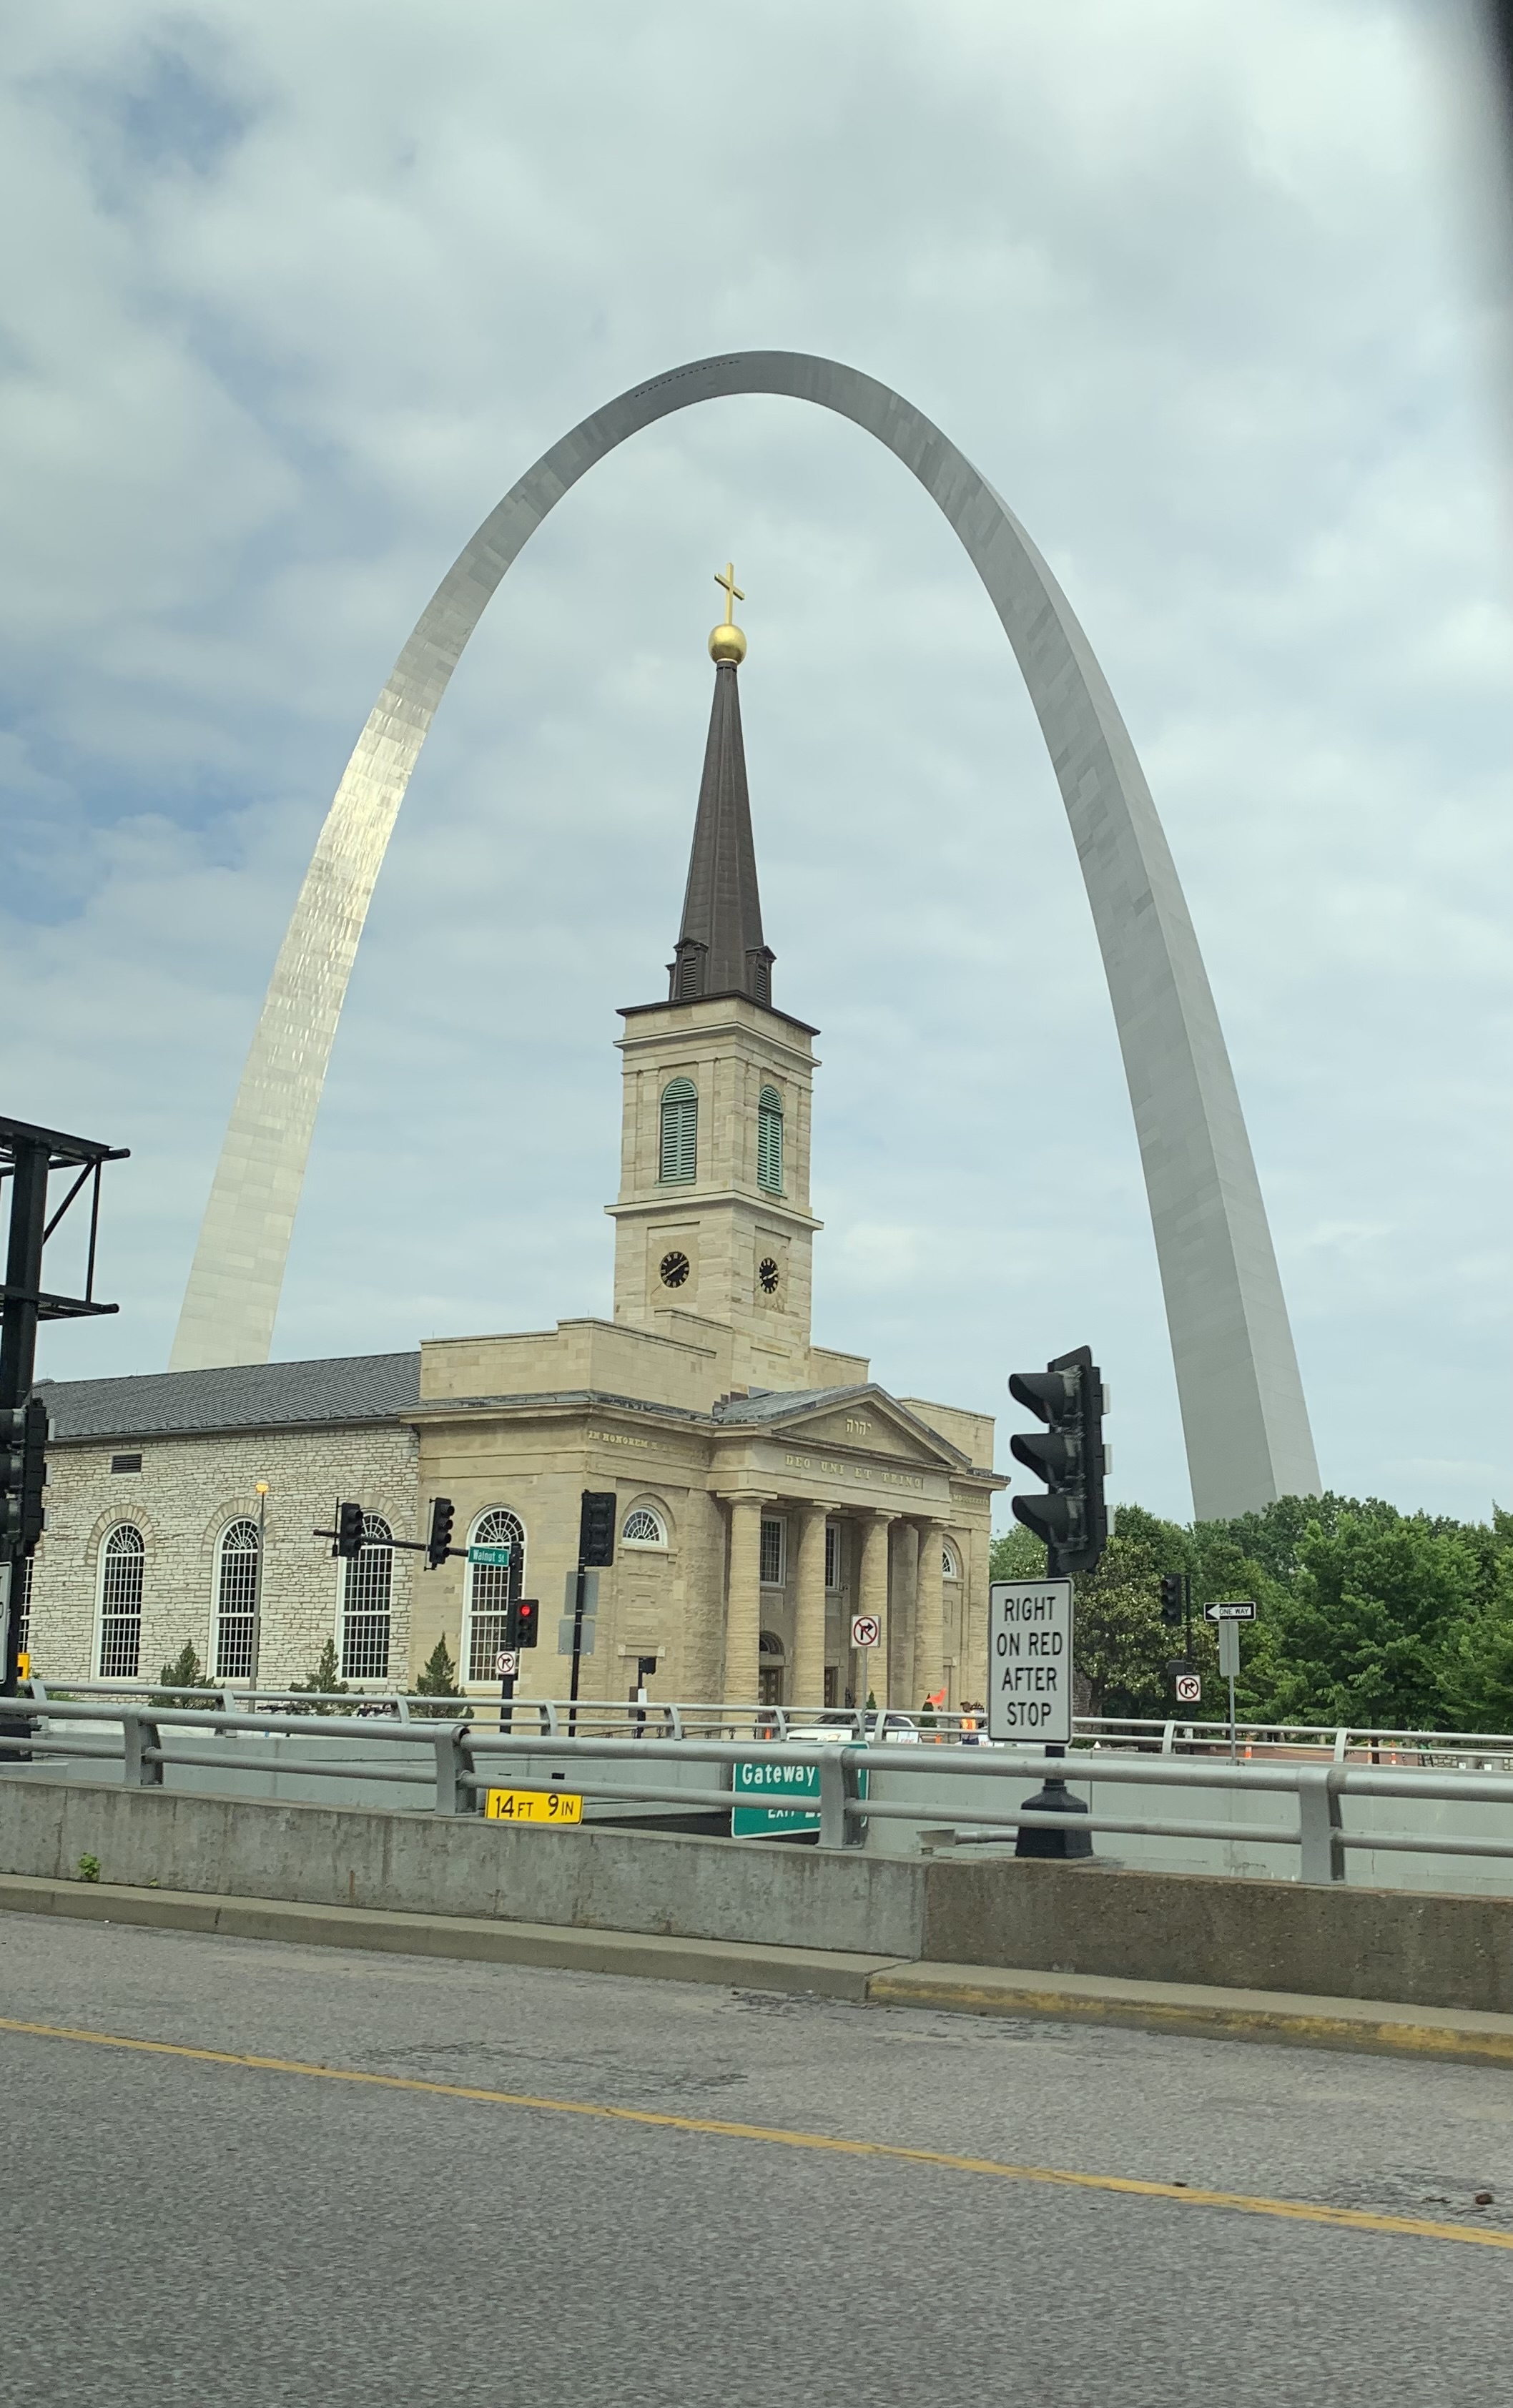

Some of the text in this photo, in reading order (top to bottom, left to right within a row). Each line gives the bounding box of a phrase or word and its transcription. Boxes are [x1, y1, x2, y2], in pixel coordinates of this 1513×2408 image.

[847, 1418, 872, 1436] יהוה
[588, 1431, 601, 1440] IN
[602, 1433, 648, 1449] HONOREM
[786, 1455, 921, 1489] DEO UNI ET TRINO
[473, 1549, 505, 1563] Walnut St
[1004, 1597, 1056, 1622] RIGHT
[997, 1632, 1063, 1657] ON RED
[1002, 1667, 1058, 1692] AFTER
[1007, 1702, 1051, 1726] STOP
[742, 1763, 815, 1787] Gateway
[496, 1795, 573, 1817] 14 FT 9 IN
